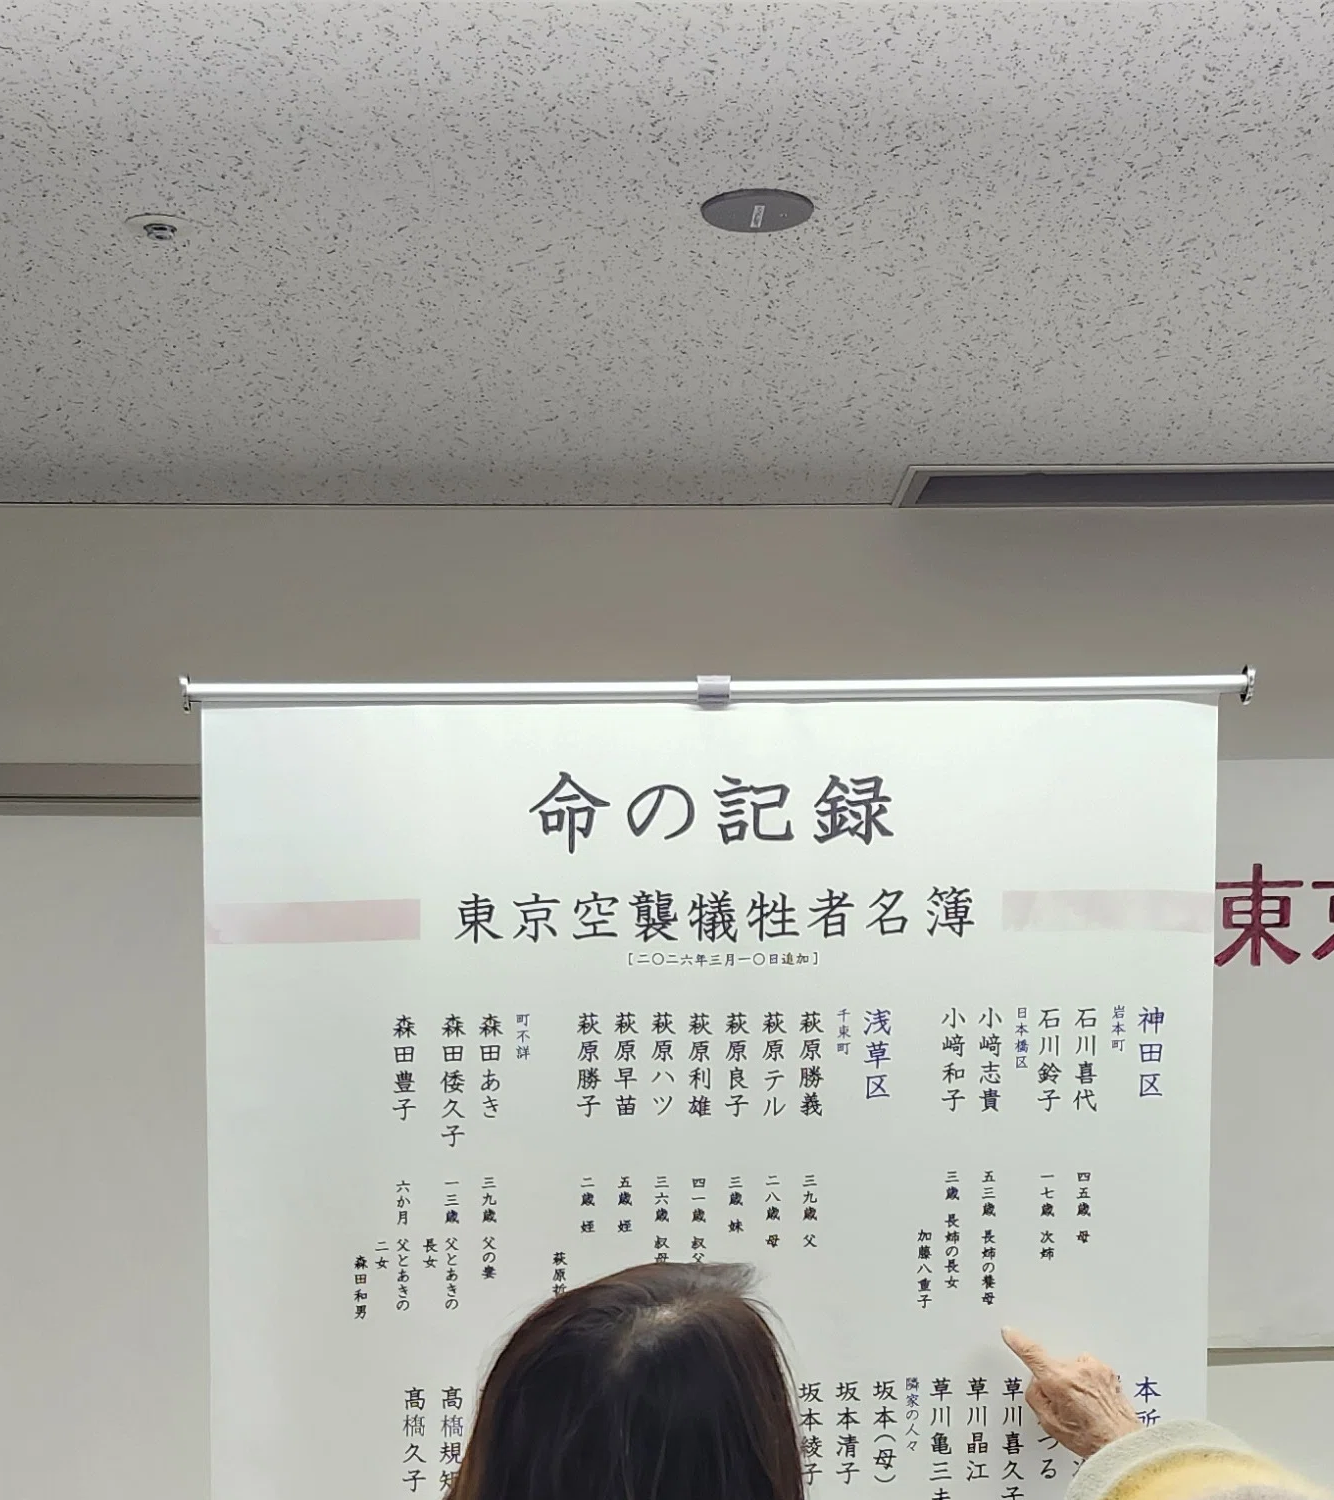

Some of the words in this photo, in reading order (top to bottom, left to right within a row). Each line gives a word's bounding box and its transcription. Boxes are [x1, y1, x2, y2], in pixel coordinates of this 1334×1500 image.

[529, 772, 895, 854] 命の記録
[455, 886, 975, 944] 東京空襲犠牲者名簿
[392, 1015, 417, 1121] 森田豊子
[479, 1013, 503, 1118] 森田あき
[577, 1012, 602, 1118] 萩原勝子
[614, 1012, 639, 1116] 萩原早苗
[651, 1012, 676, 1115] 萩原ハツ
[688, 1013, 712, 1117] 萩原利雄
[725, 1012, 749, 1117] 萩原良子
[762, 1011, 787, 1116] 萩原テル
[799, 1011, 824, 1116] 萩原勝義
[864, 1009, 891, 1099] 浅草区
[1015, 1008, 1028, 1068] 日本橋区
[1038, 1009, 1062, 1112] 石川鈴子
[1073, 1008, 1097, 1112] 石川喜代
[1112, 1005, 1126, 1052] 岩本町
[1138, 1007, 1164, 1097] 神田区
[440, 1014, 466, 1147] 森田倭久子
[354, 1255, 368, 1319] 森田和男
[917, 1229, 932, 1308] 加藤八重子
[836, 1381, 860, 1484] 坂本清子
[966, 1377, 989, 1481] 草川晶江
